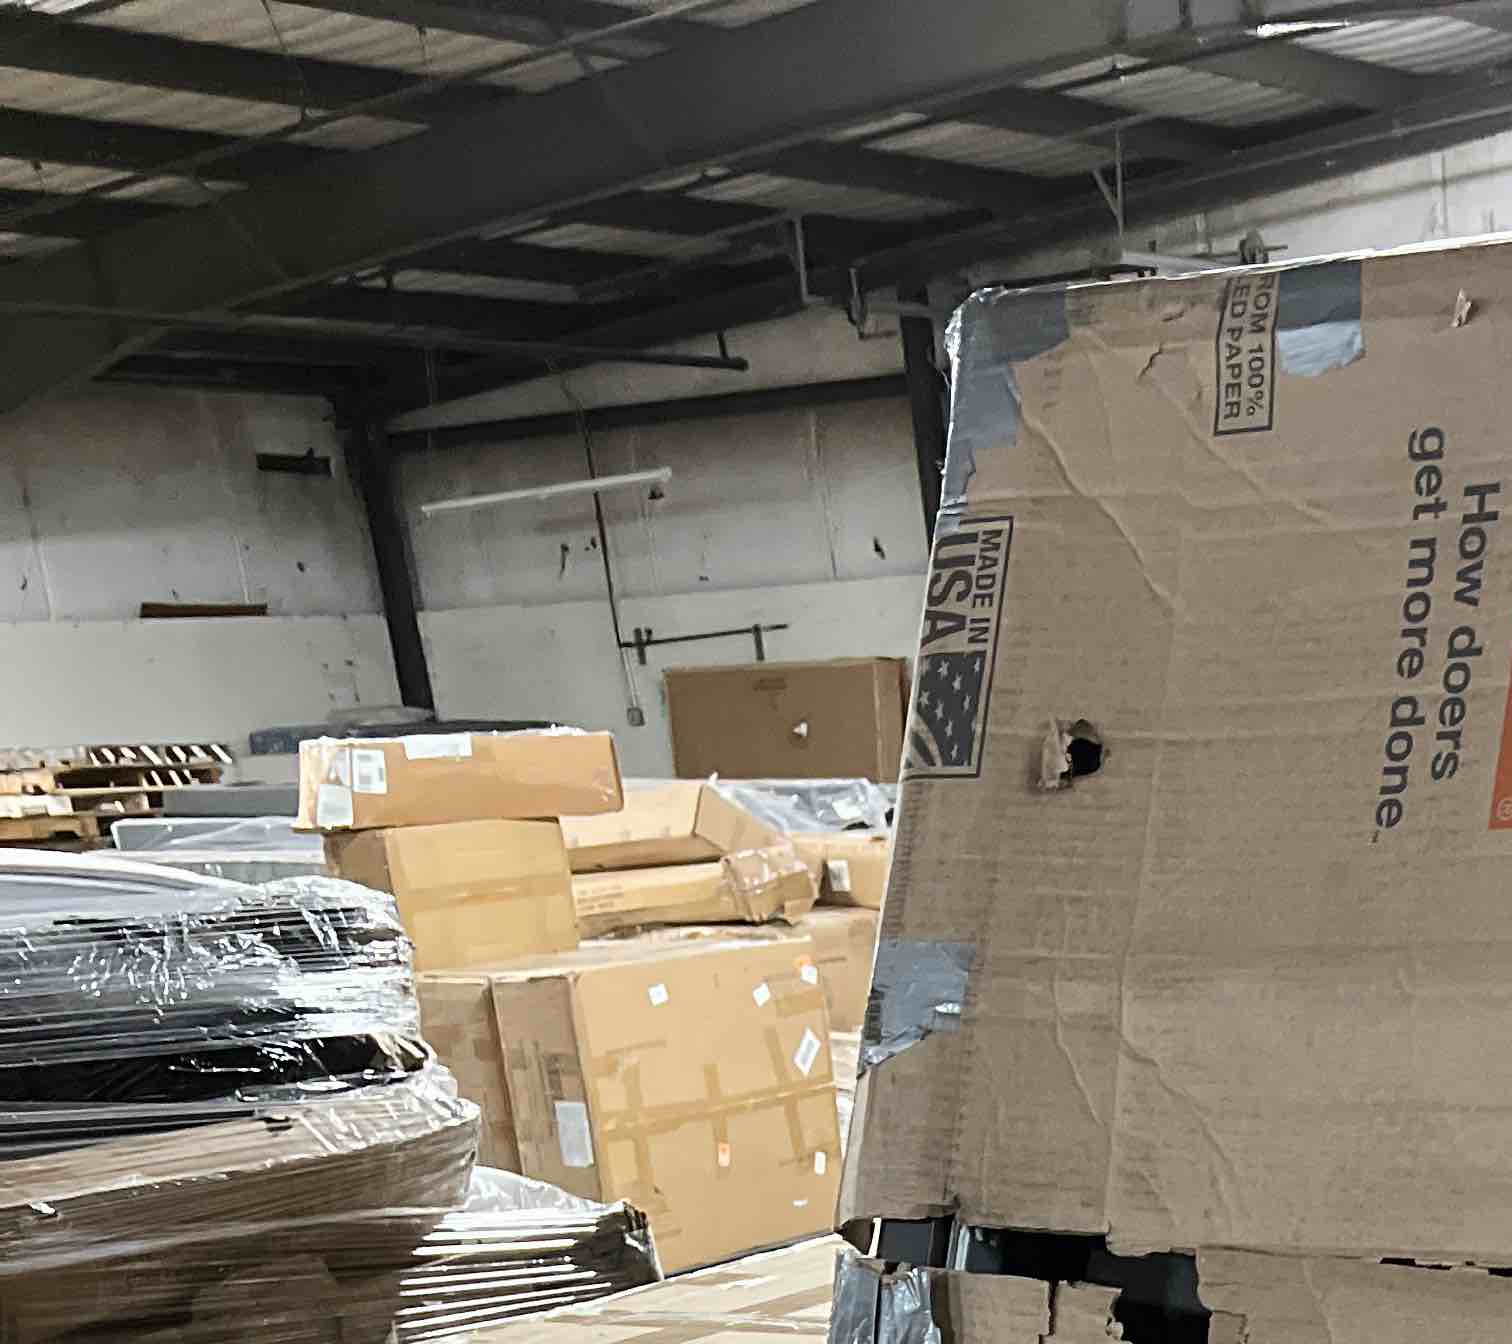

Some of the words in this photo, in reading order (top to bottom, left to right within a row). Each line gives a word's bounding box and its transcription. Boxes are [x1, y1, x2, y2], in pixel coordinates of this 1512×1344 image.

[1250, 273, 1275, 334] ROM
[1224, 326, 1243, 420] PAPER
[1246, 343, 1265, 417] 100%
[1408, 426, 1446, 520] get
[920, 532, 979, 650] USA
[973, 529, 1004, 609] MADE
[1455, 482, 1500, 607] How
[967, 617, 990, 645] IN
[1396, 537, 1439, 680] more
[1430, 626, 1483, 781] doers
